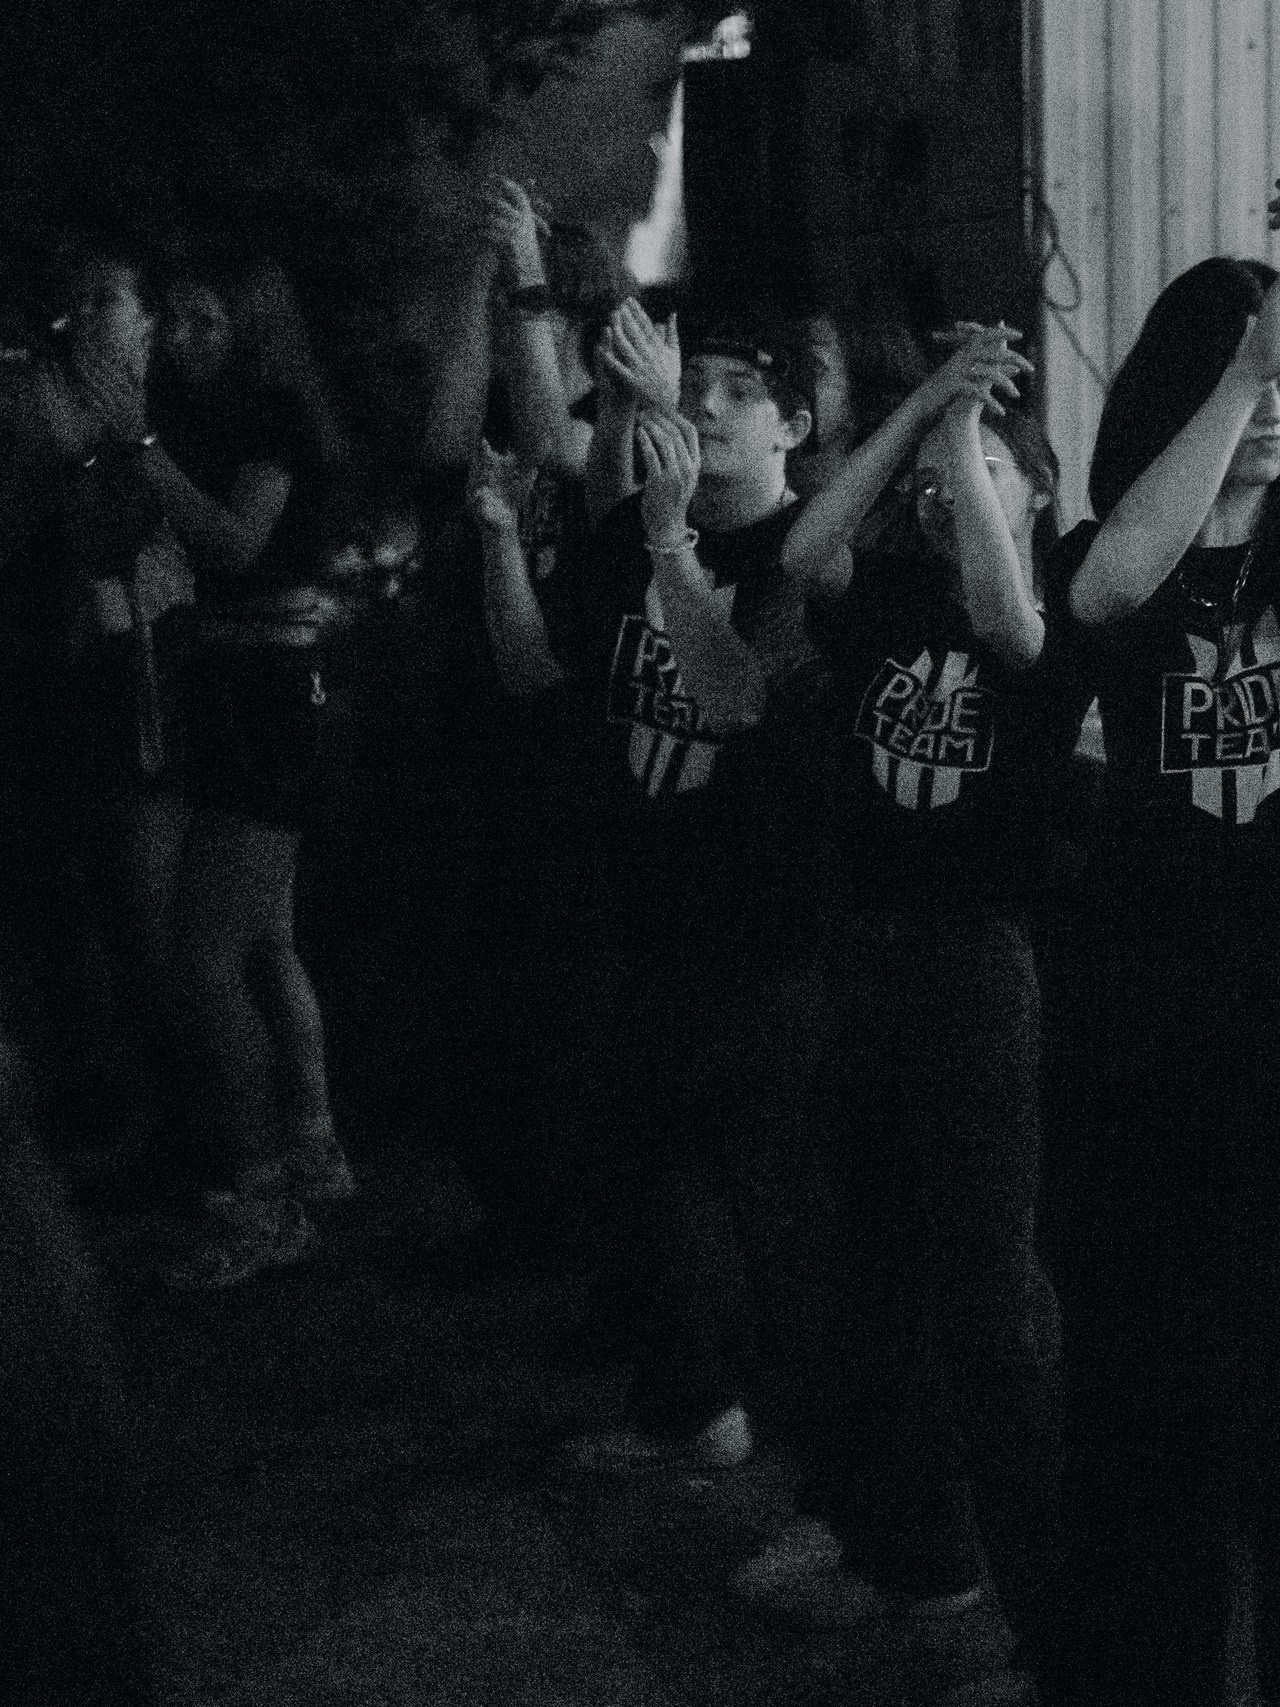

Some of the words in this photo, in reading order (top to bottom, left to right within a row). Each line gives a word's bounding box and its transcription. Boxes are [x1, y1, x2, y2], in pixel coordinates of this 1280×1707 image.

[628, 681, 704, 732] TEA
[875, 672, 984, 735] PRDE
[872, 709, 976, 763] TEAM
